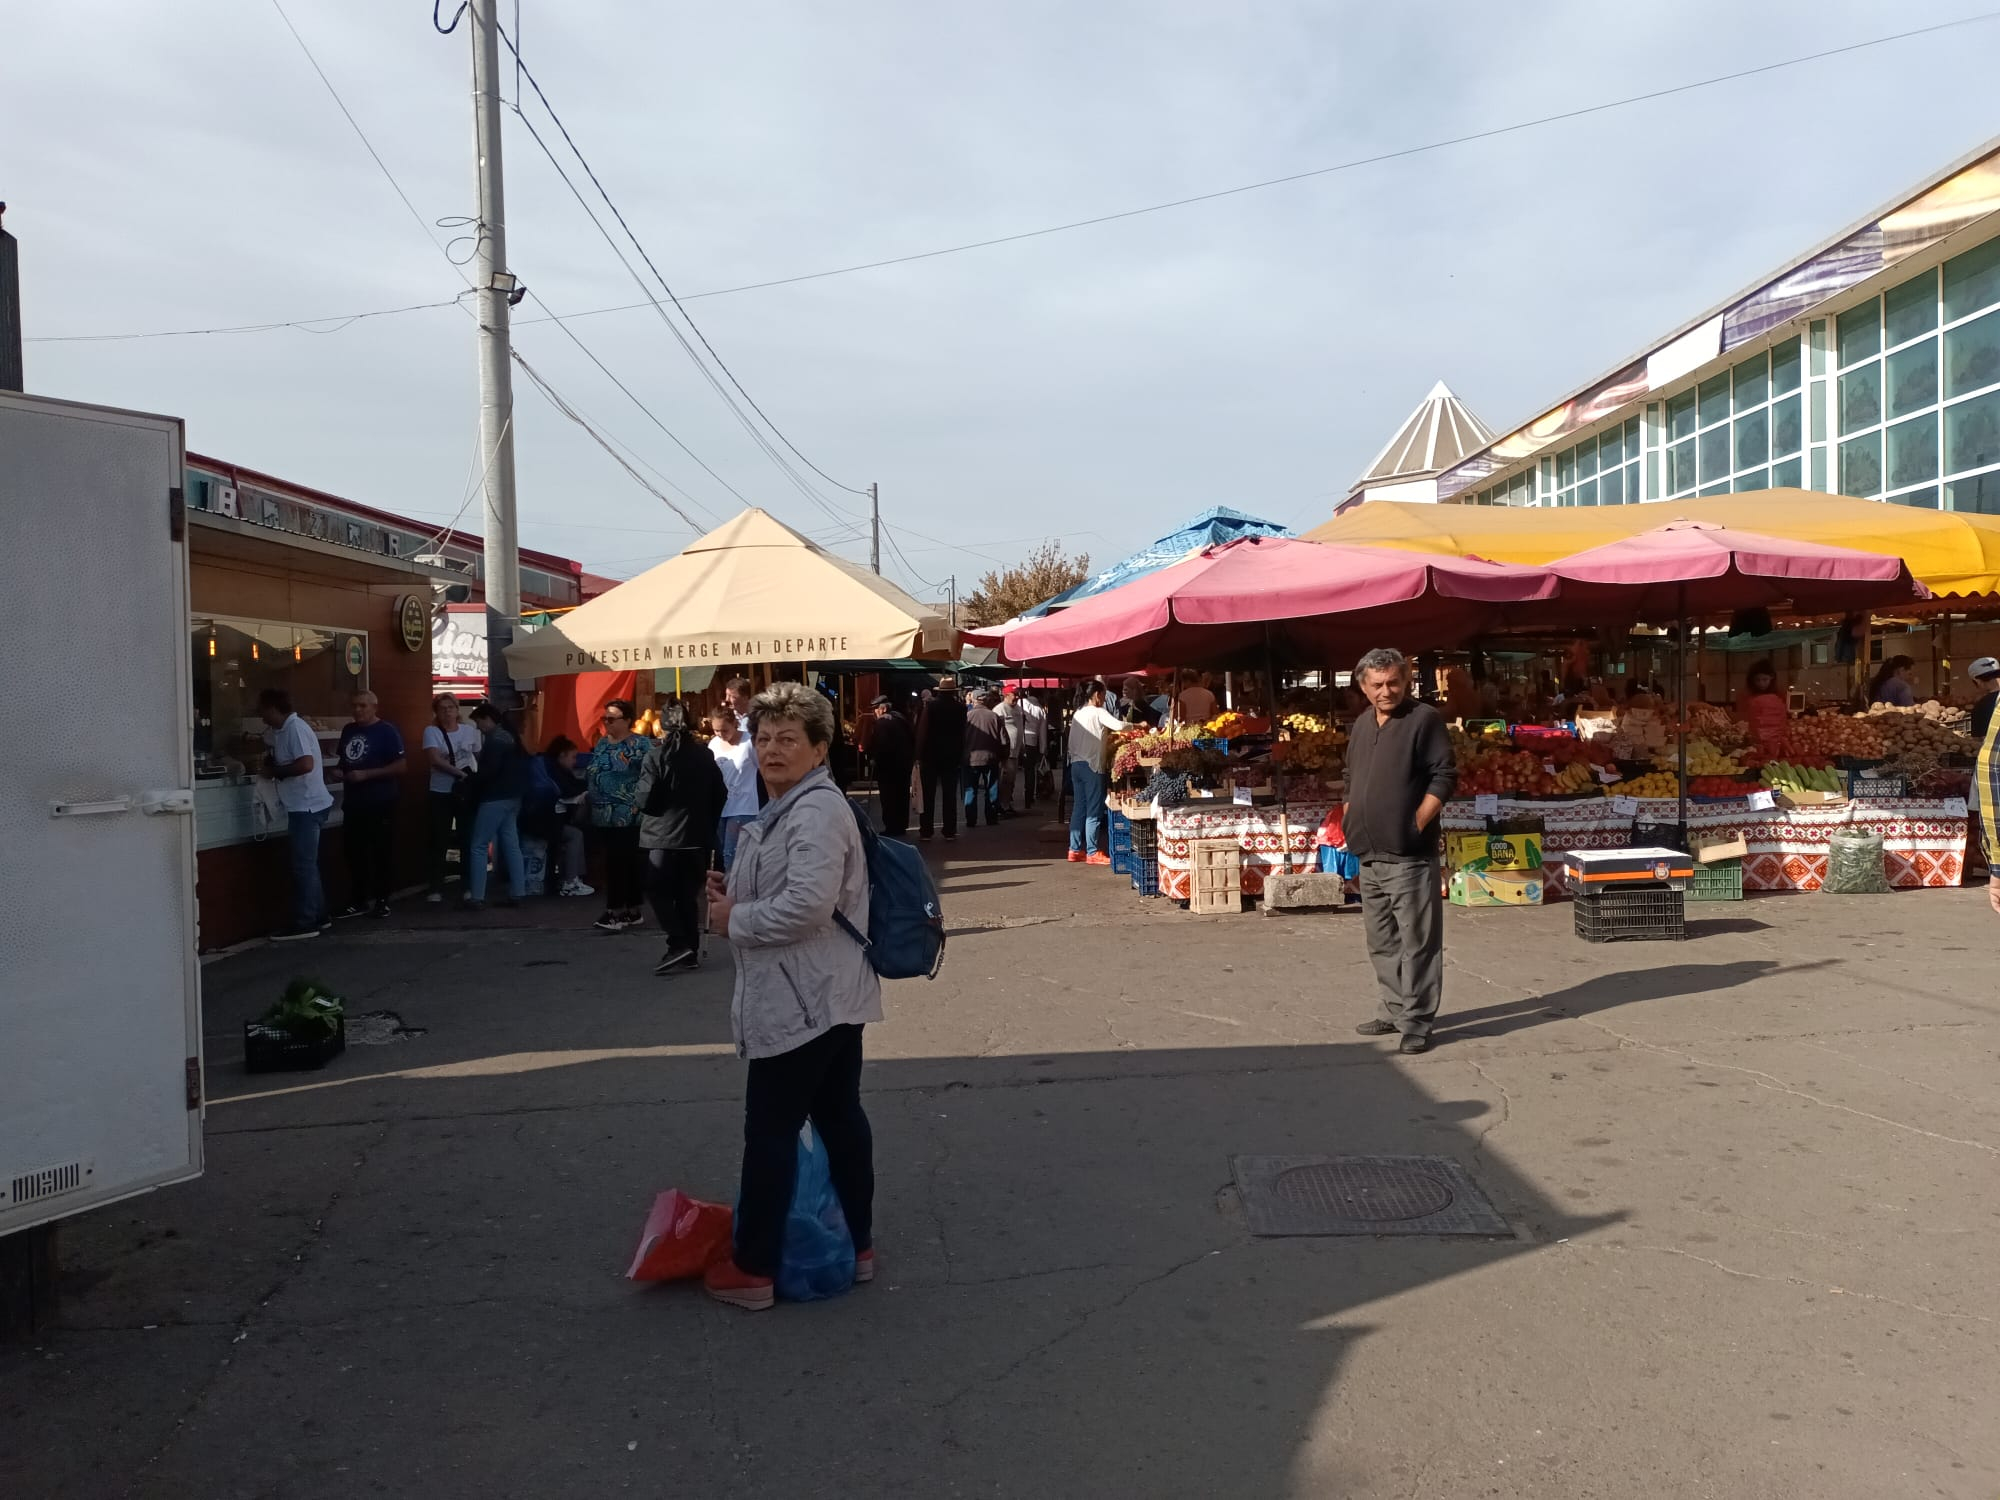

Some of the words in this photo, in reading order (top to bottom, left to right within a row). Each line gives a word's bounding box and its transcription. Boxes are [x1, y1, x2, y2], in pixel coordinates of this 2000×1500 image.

[566, 647, 652, 666] POVESTEA
[663, 642, 719, 660] MERGE
[731, 640, 761, 656] MAI
[773, 636, 848, 654] DEPARTE
